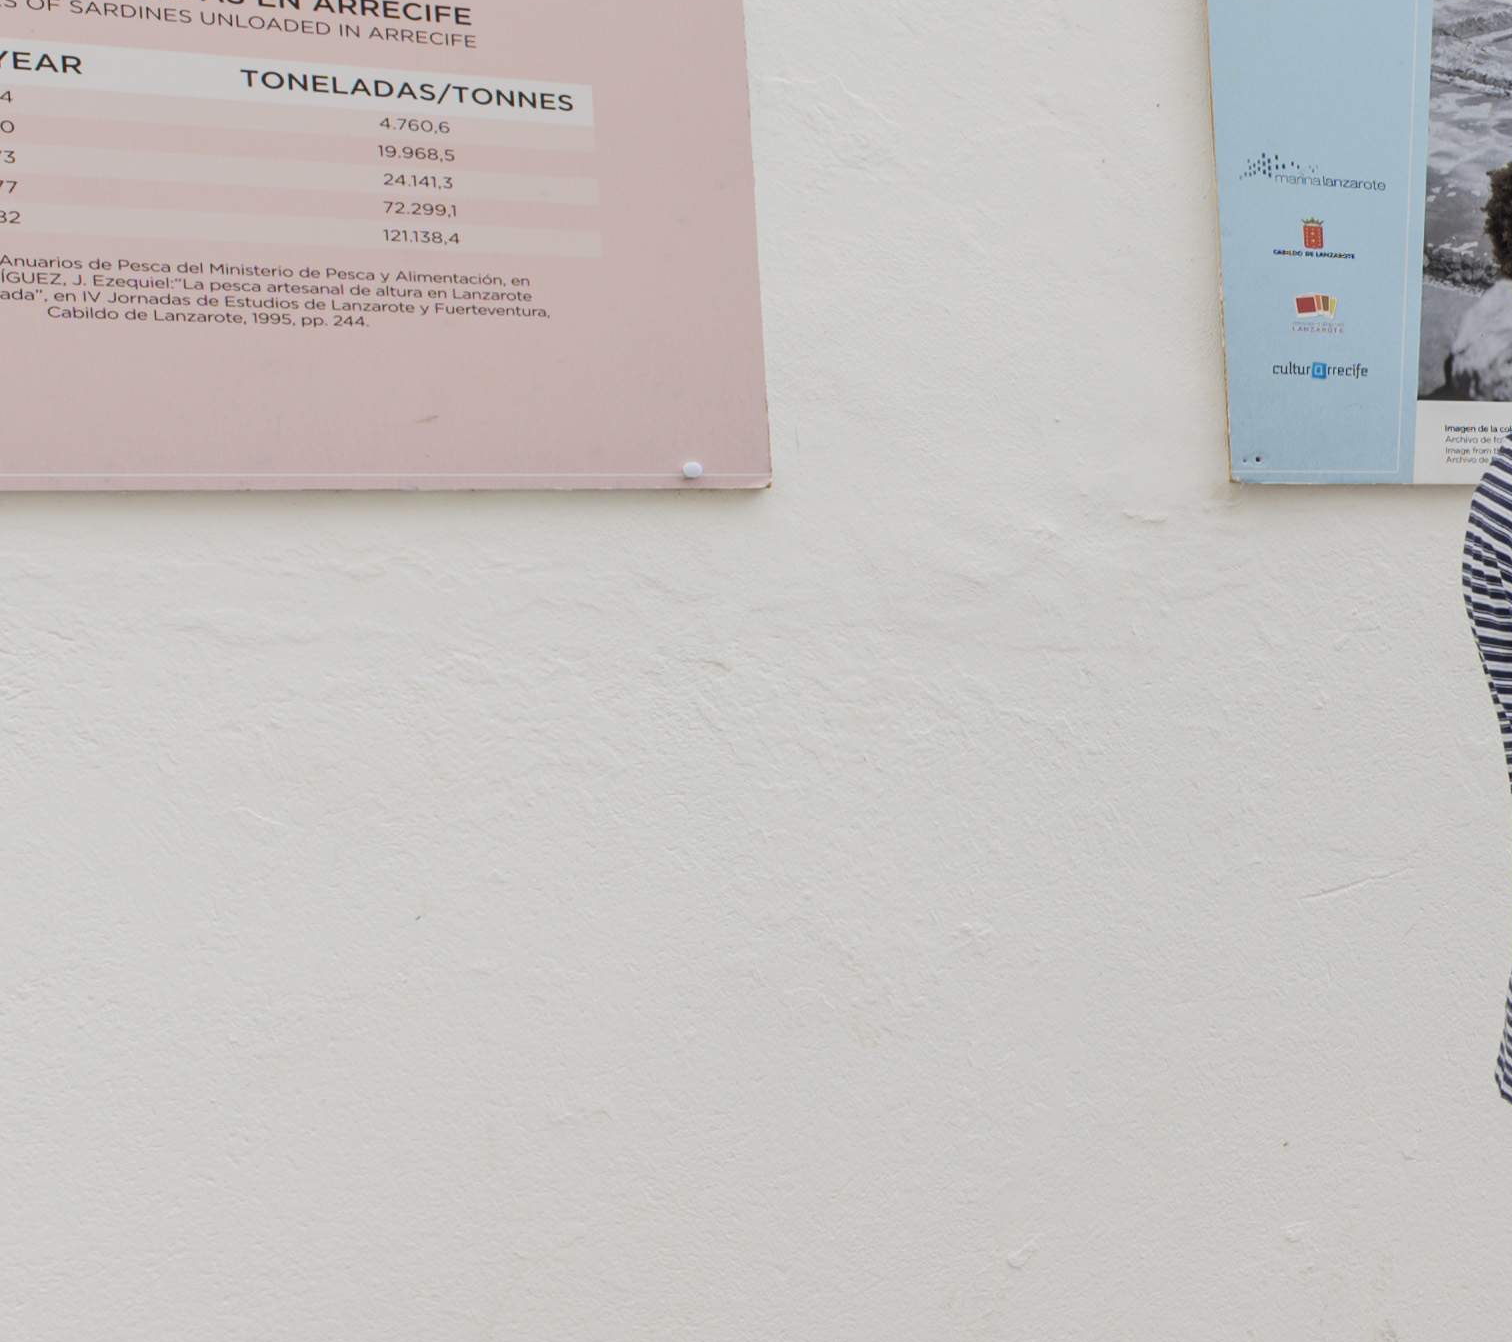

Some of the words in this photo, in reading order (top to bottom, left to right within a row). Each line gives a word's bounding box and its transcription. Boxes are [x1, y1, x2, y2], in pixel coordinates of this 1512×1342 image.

[69, 0, 192, 24] SARDINES
[199, 11, 331, 36] UNLOADED
[338, 23, 360, 38] IN
[368, 26, 475, 48] ARRECIFE
[239, 68, 573, 112] TONELADAS/TONNES
[379, 116, 450, 134] 4.760,6
[377, 144, 455, 162] 19.968,5
[383, 172, 453, 190] 24.141,3
[383, 200, 457, 218] 72.299,1
[383, 228, 459, 245] 121.138,4
[47, 305, 119, 320] Cabildo
[124, 308, 148, 321] de
[153, 309, 247, 325] Lanzarote,
[252, 312, 296, 326] 1995,
[301, 316, 328, 328] pp.
[333, 314, 369, 327] 244.
[1444, 424, 1476, 434] Imagen
